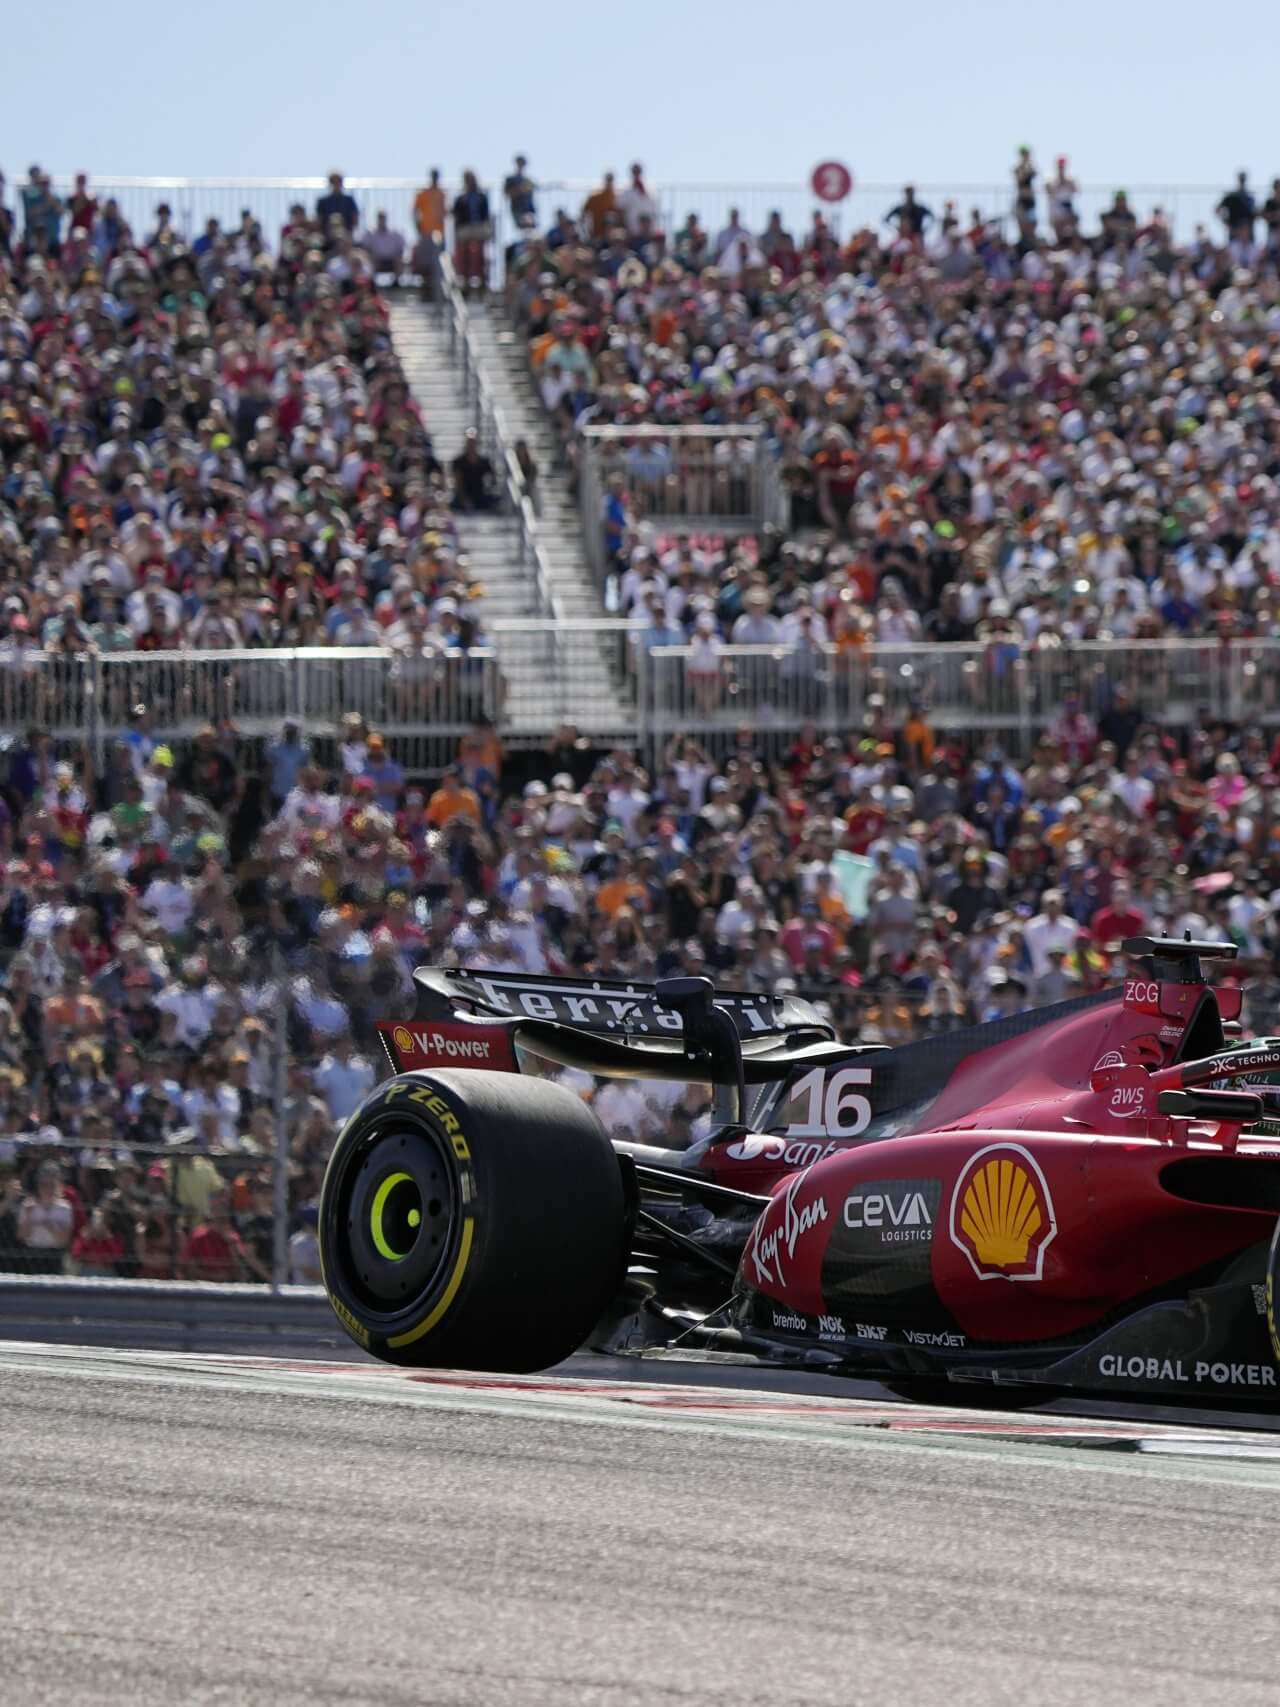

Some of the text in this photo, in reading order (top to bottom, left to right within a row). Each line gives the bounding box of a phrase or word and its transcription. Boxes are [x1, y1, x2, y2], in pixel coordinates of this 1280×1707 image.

[1125, 982, 1160, 1003] ZCG
[475, 977, 772, 1032] Ferrai
[414, 1032, 490, 1059] V-Power
[785, 1067, 872, 1137] 16
[1111, 1086, 1145, 1105] aws
[408, 1086, 471, 1160] ZERO
[881, 1230, 932, 1242] LOGISTICS
[772, 1310, 807, 1331] brembo
[818, 1314, 846, 1334] NGK
[856, 1323, 888, 1341] SKF
[1099, 1354, 1277, 1386] GLOBAL POKER
